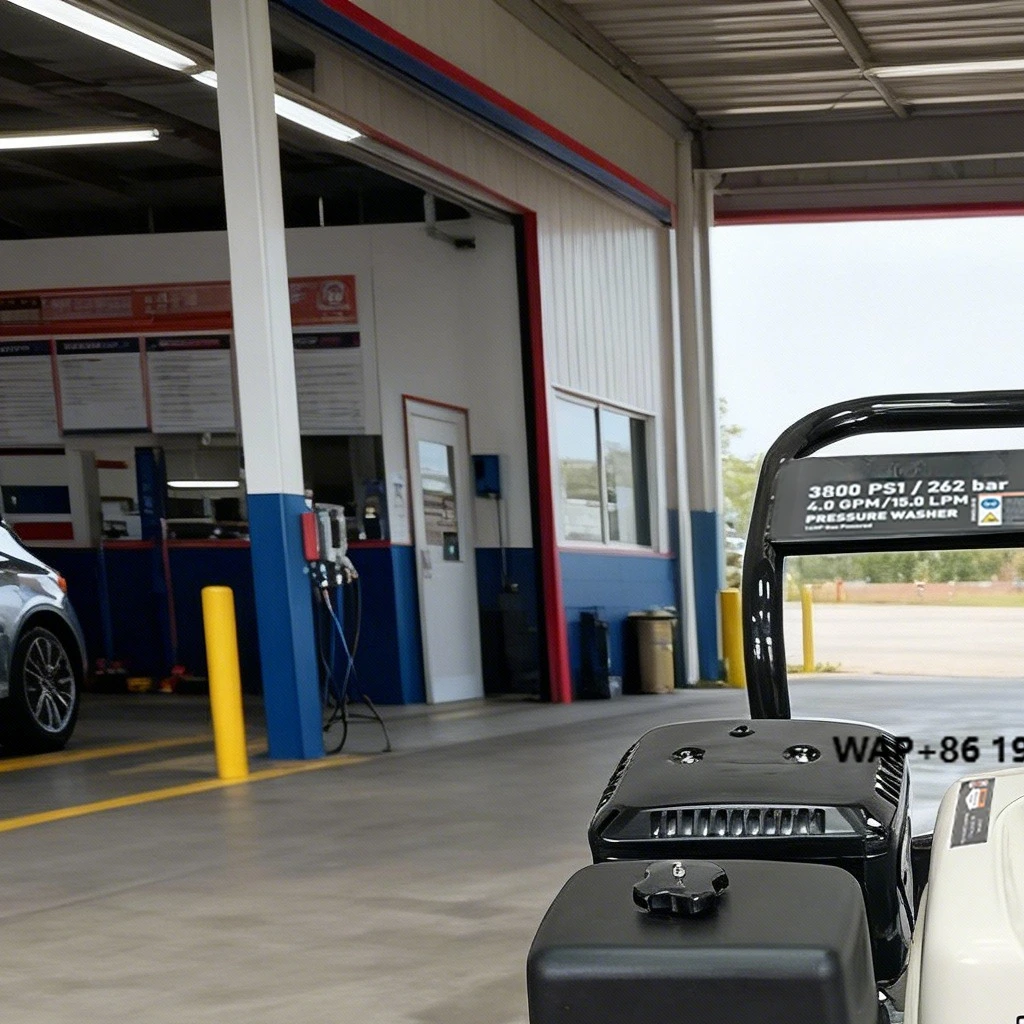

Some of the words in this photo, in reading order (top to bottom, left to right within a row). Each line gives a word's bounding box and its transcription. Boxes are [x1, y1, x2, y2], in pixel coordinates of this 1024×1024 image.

[808, 484, 861, 499] 3800
[911, 480, 923, 495] /
[927, 479, 966, 494] 262
[972, 479, 1009, 492] bar
[806, 500, 834, 511] 4.0
[838, 496, 924, 510] GPM/15.0
[929, 494, 969, 507] LPM
[805, 511, 887, 524] PRESSURE
[890, 508, 958, 520] WASHER
